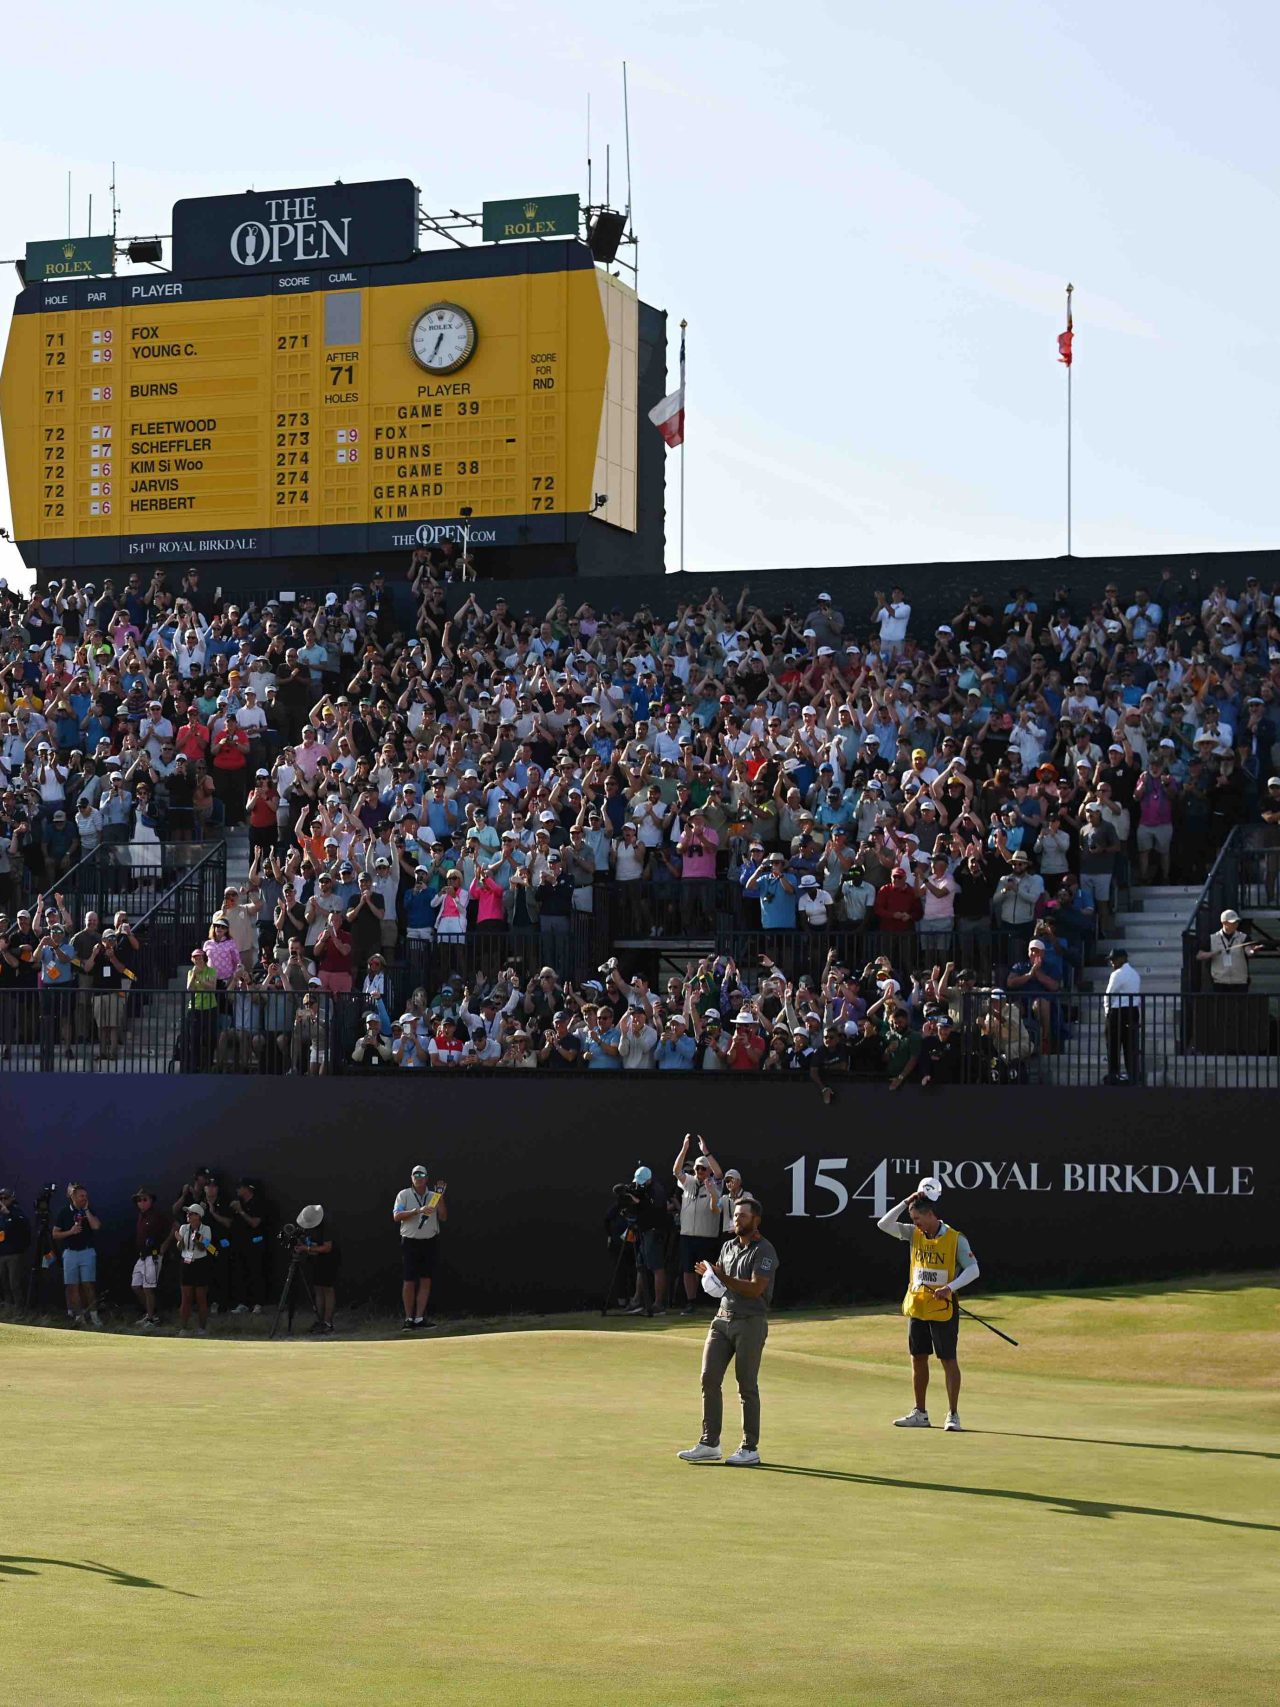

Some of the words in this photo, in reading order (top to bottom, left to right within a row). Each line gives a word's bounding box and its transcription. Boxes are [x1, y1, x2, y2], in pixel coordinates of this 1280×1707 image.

[265, 196, 317, 222] THE
[504, 221, 556, 235] ROLEX
[230, 217, 352, 266] OPEN
[45, 261, 92, 274] ROLEX
[45, 295, 68, 305] HOLE
[87, 292, 107, 302] PAR
[131, 284, 183, 298] PLAYER
[278, 276, 310, 288] SCORE
[45, 333, 65, 347] 71
[131, 326, 159, 340] FOX
[428, 323, 454, 331] ROLEX
[45, 352, 65, 366] 72
[132, 344, 181, 359] YOUNG
[183, 343, 198, 356] C.
[277, 335, 308, 350] 271
[326, 352, 359, 363] AFTER
[531, 353, 557, 364] SCORE
[330, 365, 354, 386] 71
[535, 366, 552, 375] FOR
[45, 390, 64, 404] 71
[130, 383, 178, 398] BURNS
[418, 383, 471, 398] PLAYER
[533, 378, 555, 390] RND
[324, 393, 359, 404] HOLES
[398, 403, 443, 419] GAME
[458, 401, 480, 416] 39
[44, 428, 65, 441] 72
[131, 419, 217, 436] FLEETWOOD
[276, 412, 310, 427] 273
[375, 426, 407, 441] FOX
[44, 447, 65, 460] 72
[131, 438, 212, 455] SCHEFFLER
[276, 432, 310, 447] 273
[374, 444, 431, 460] BURNS
[44, 466, 65, 479] 72
[131, 460, 155, 474] KIM
[158, 459, 171, 473] Si
[174, 459, 204, 472] Woo
[276, 451, 310, 466] 274
[398, 463, 443, 479] GAME
[457, 461, 480, 475] 38
[44, 485, 65, 498] 72
[131, 479, 179, 493] JARVIS
[276, 470, 310, 486] 274
[374, 483, 443, 499] GERARD
[532, 476, 555, 491] 72
[44, 504, 64, 517] 72
[130, 497, 196, 512] HERBERT
[276, 490, 309, 505] 274
[374, 504, 408, 519] KIM
[532, 496, 554, 510] 72
[159, 540, 197, 553] ROYAL
[199, 538, 257, 552] BIRKDALE
[784, 1155, 920, 1218] 154TH
[931, 1159, 1052, 1192] ROYAL
[1064, 1163, 1256, 1196] BIRKDALE
